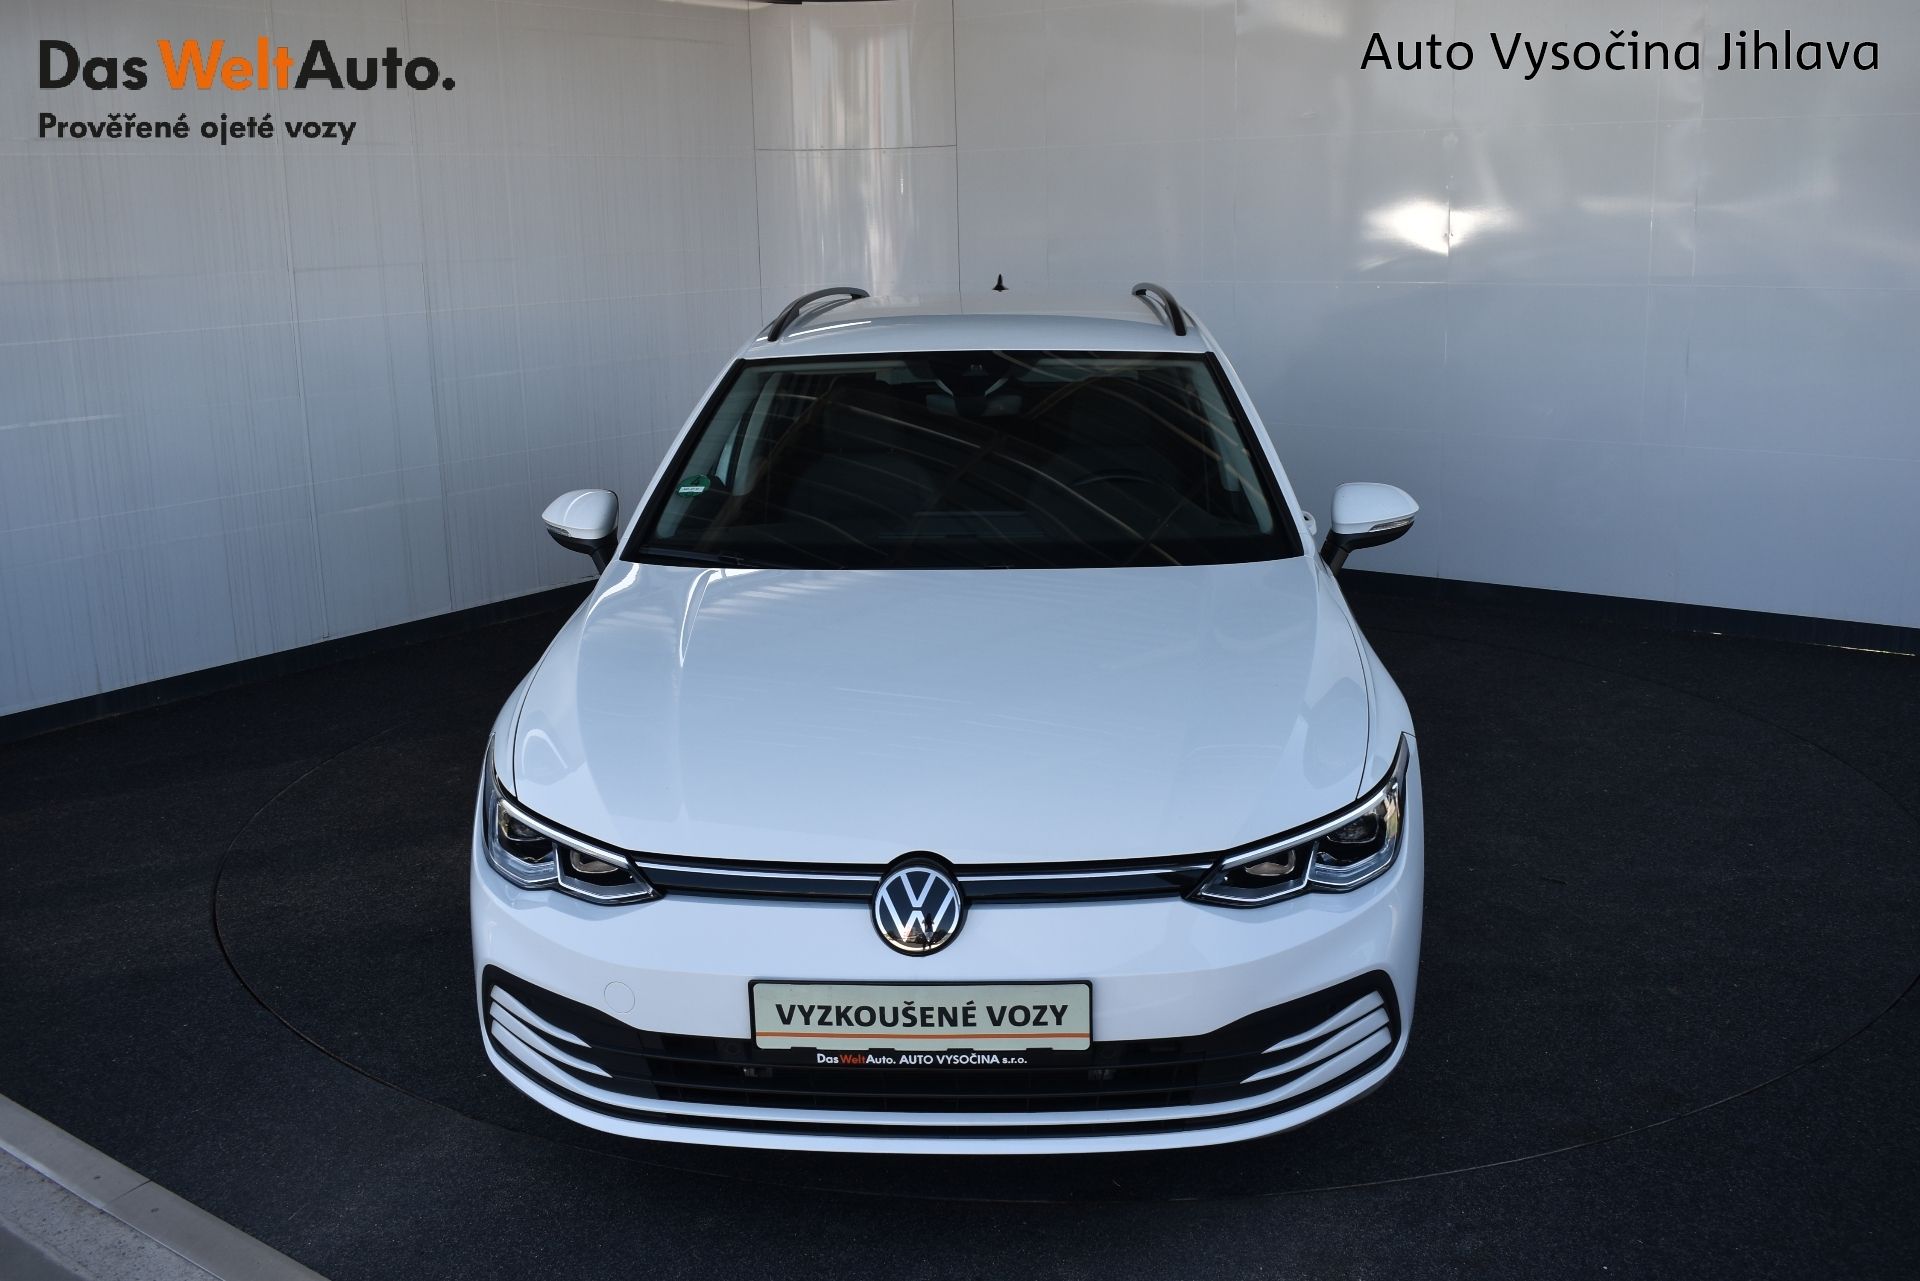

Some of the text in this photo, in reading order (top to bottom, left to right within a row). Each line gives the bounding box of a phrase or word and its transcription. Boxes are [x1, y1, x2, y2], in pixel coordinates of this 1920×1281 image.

[775, 1000, 1069, 1028] VYZKOUŠENÉ VOZY
[899, 1054, 934, 1065] AUTO
[936, 1052, 1001, 1065] VYSOČINA
[1001, 1057, 1028, 1065] s.r.o.
